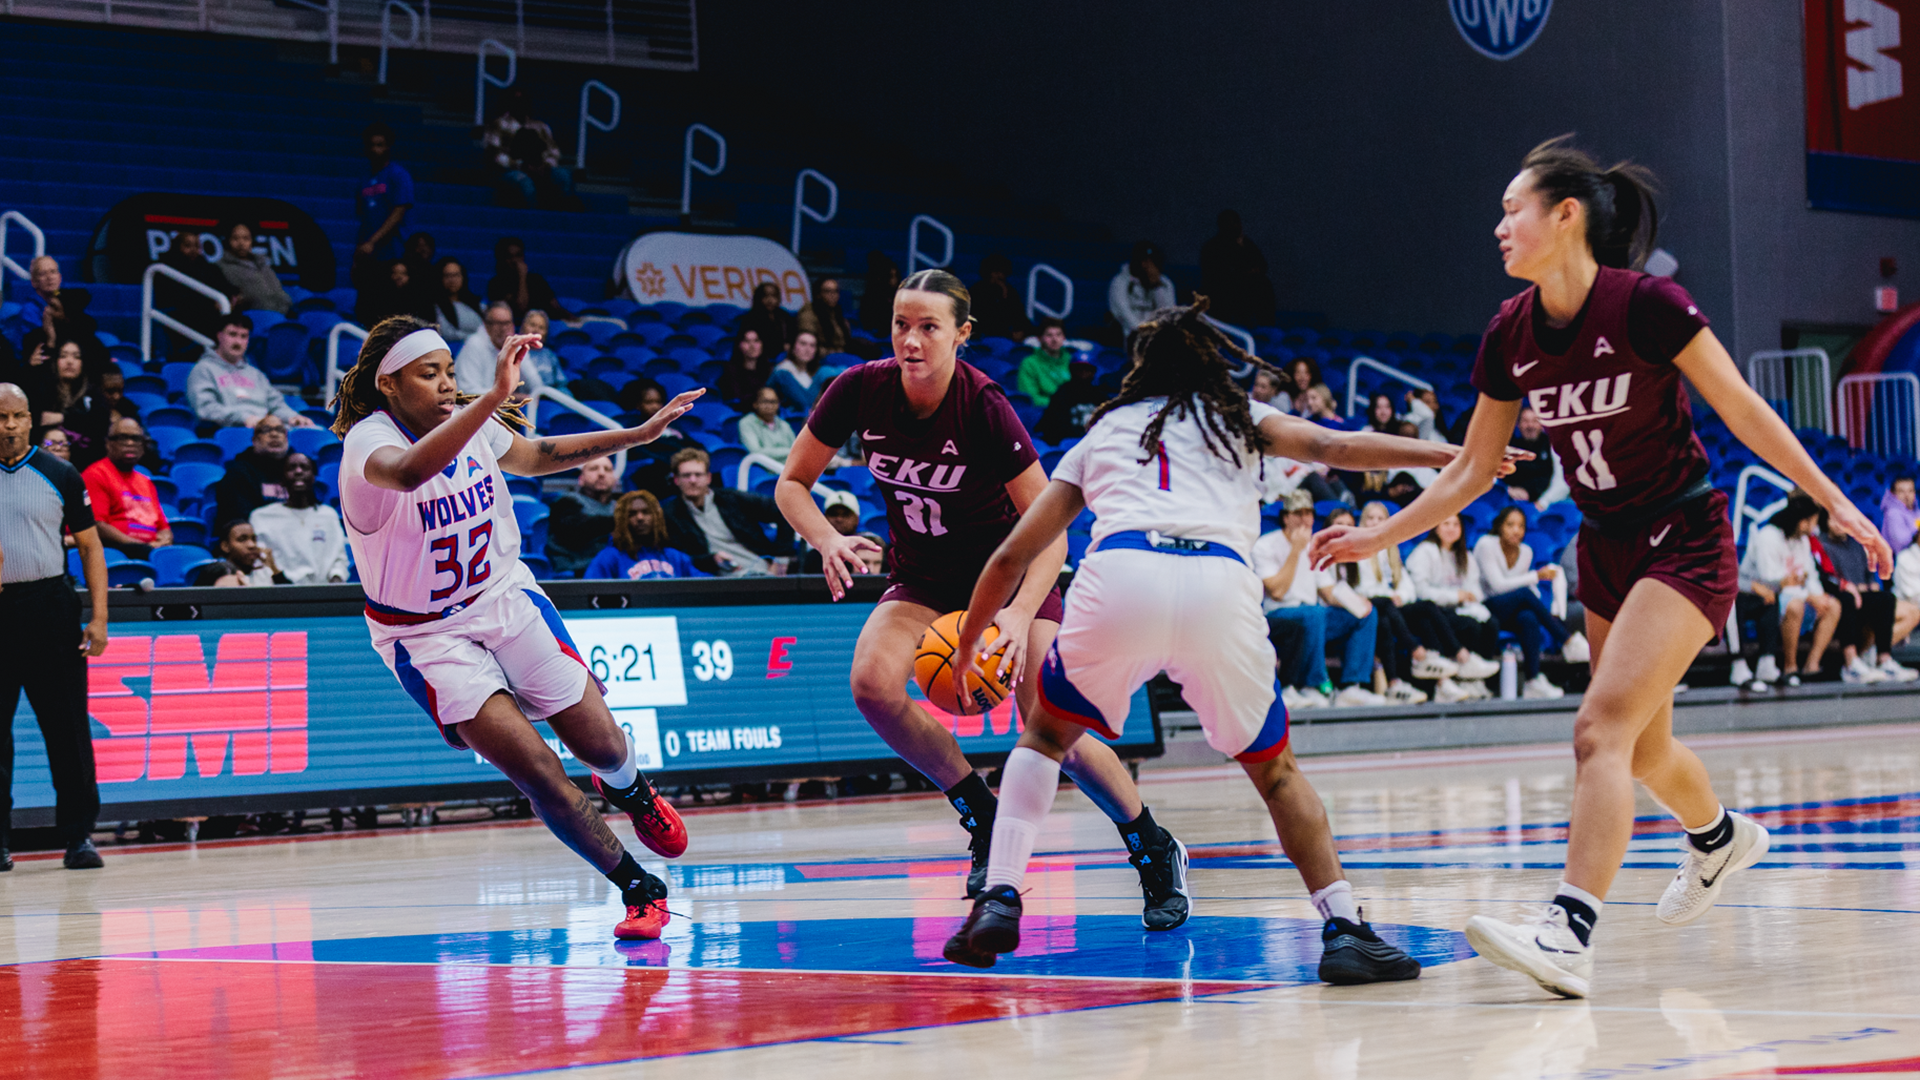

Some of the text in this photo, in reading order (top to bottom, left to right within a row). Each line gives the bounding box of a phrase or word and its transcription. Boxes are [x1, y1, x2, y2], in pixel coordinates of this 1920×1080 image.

[1528, 372, 1633, 418] EKU
[868, 452, 968, 489] EKU
[1571, 429, 1618, 490] 11
[416, 474, 495, 533] WOLVES
[893, 489, 949, 537] 31
[430, 518, 494, 602] 32
[691, 638, 735, 682] 39
[664, 725, 782, 757] 0 TEAM FOULS
